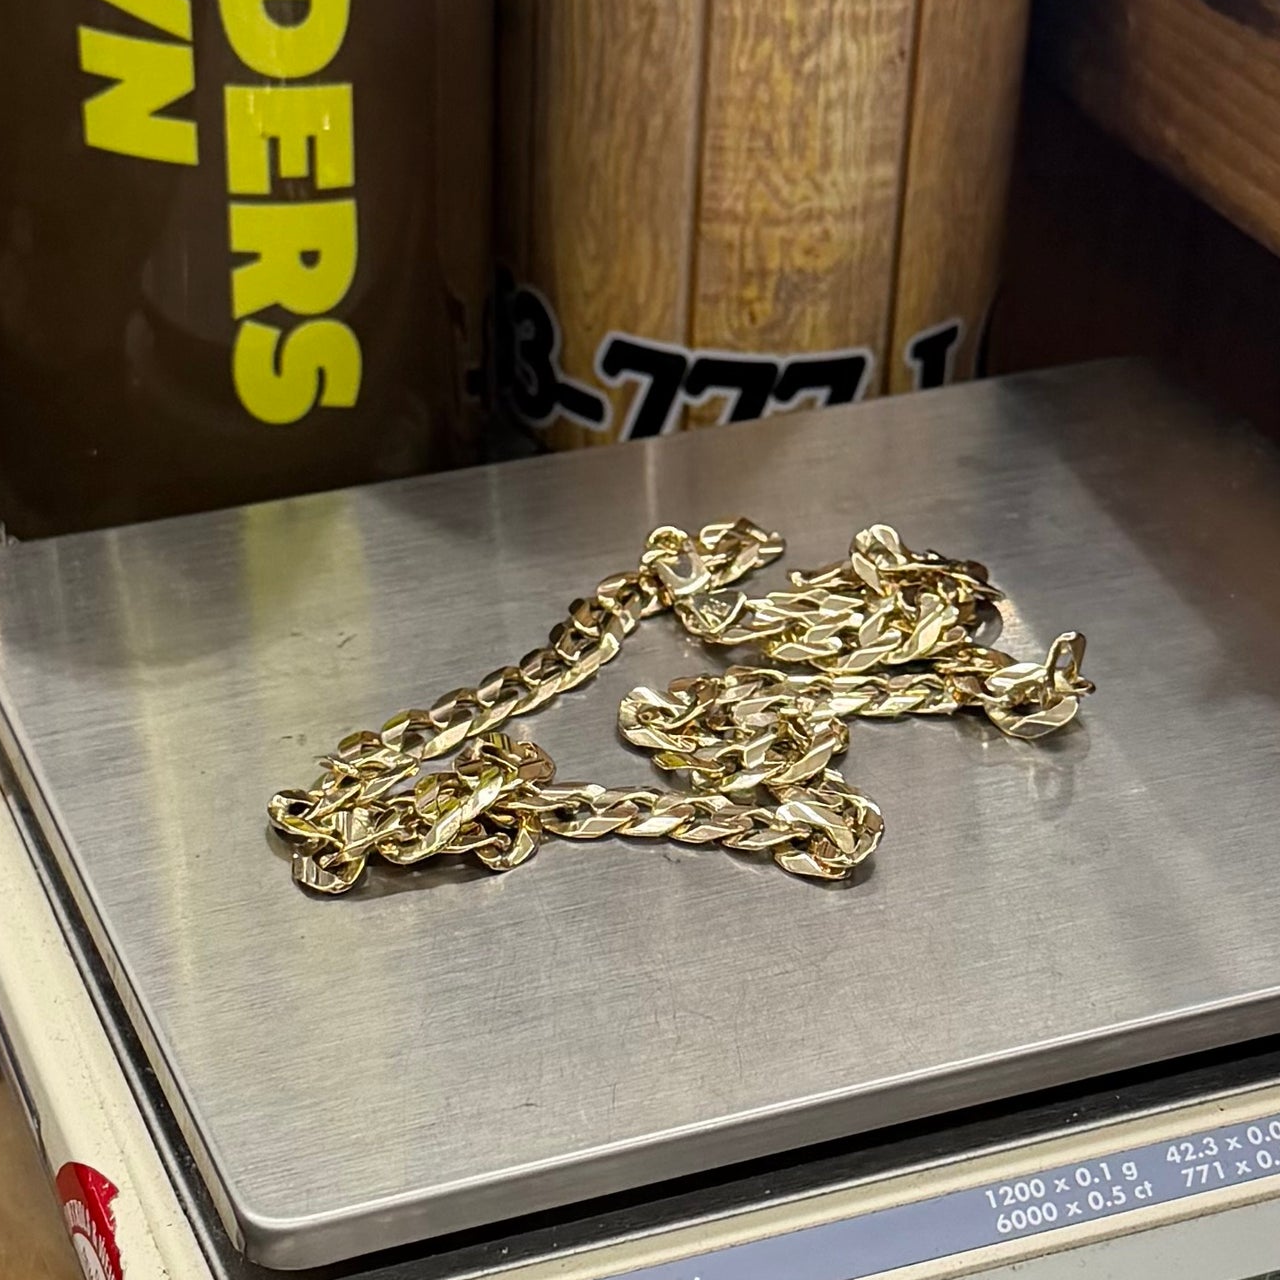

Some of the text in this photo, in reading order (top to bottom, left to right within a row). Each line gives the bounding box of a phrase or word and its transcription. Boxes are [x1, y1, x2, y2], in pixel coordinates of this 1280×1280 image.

[985, 1177, 1046, 1210] 1200
[1054, 1176, 1070, 1193] x
[1075, 1162, 1112, 1188] 0.1
[1122, 1160, 1138, 1181] g
[1166, 1137, 1219, 1165] 42.3
[1226, 1136, 1242, 1152] x
[996, 1201, 1059, 1234] 6000
[1067, 1201, 1082, 1218] x
[1088, 1188, 1127, 1213] 0.5
[1134, 1180, 1153, 1200] ct
[1180, 1161, 1225, 1189] 771
[1235, 1160, 1252, 1176] x
